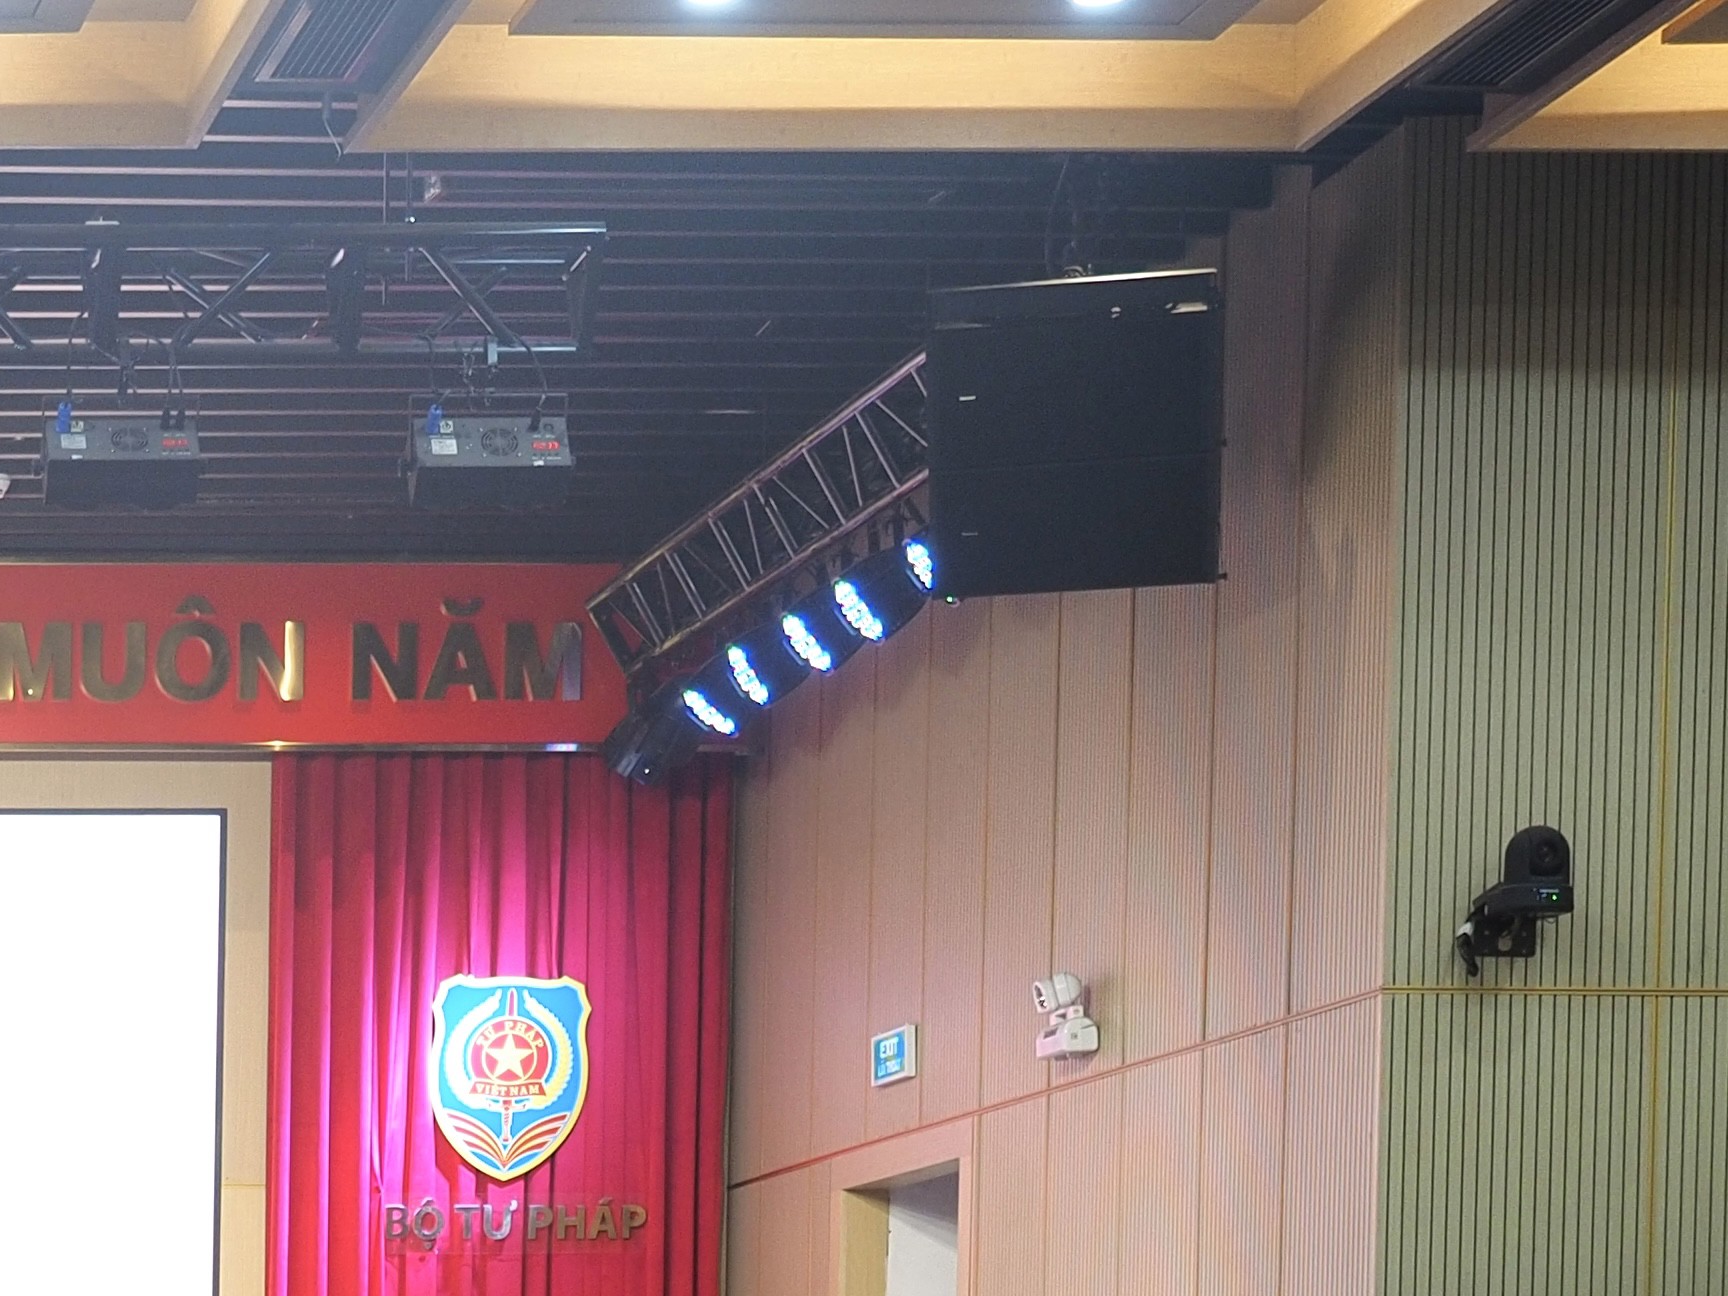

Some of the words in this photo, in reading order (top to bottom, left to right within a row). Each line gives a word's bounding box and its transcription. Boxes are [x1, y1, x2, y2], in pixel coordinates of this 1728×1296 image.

[350, 600, 584, 705] NĂM
[879, 1036, 899, 1059] EXIT
[384, 1197, 445, 1251] BỘ
[454, 1199, 517, 1241] TƯ
[527, 1197, 648, 1241] PHÁP
